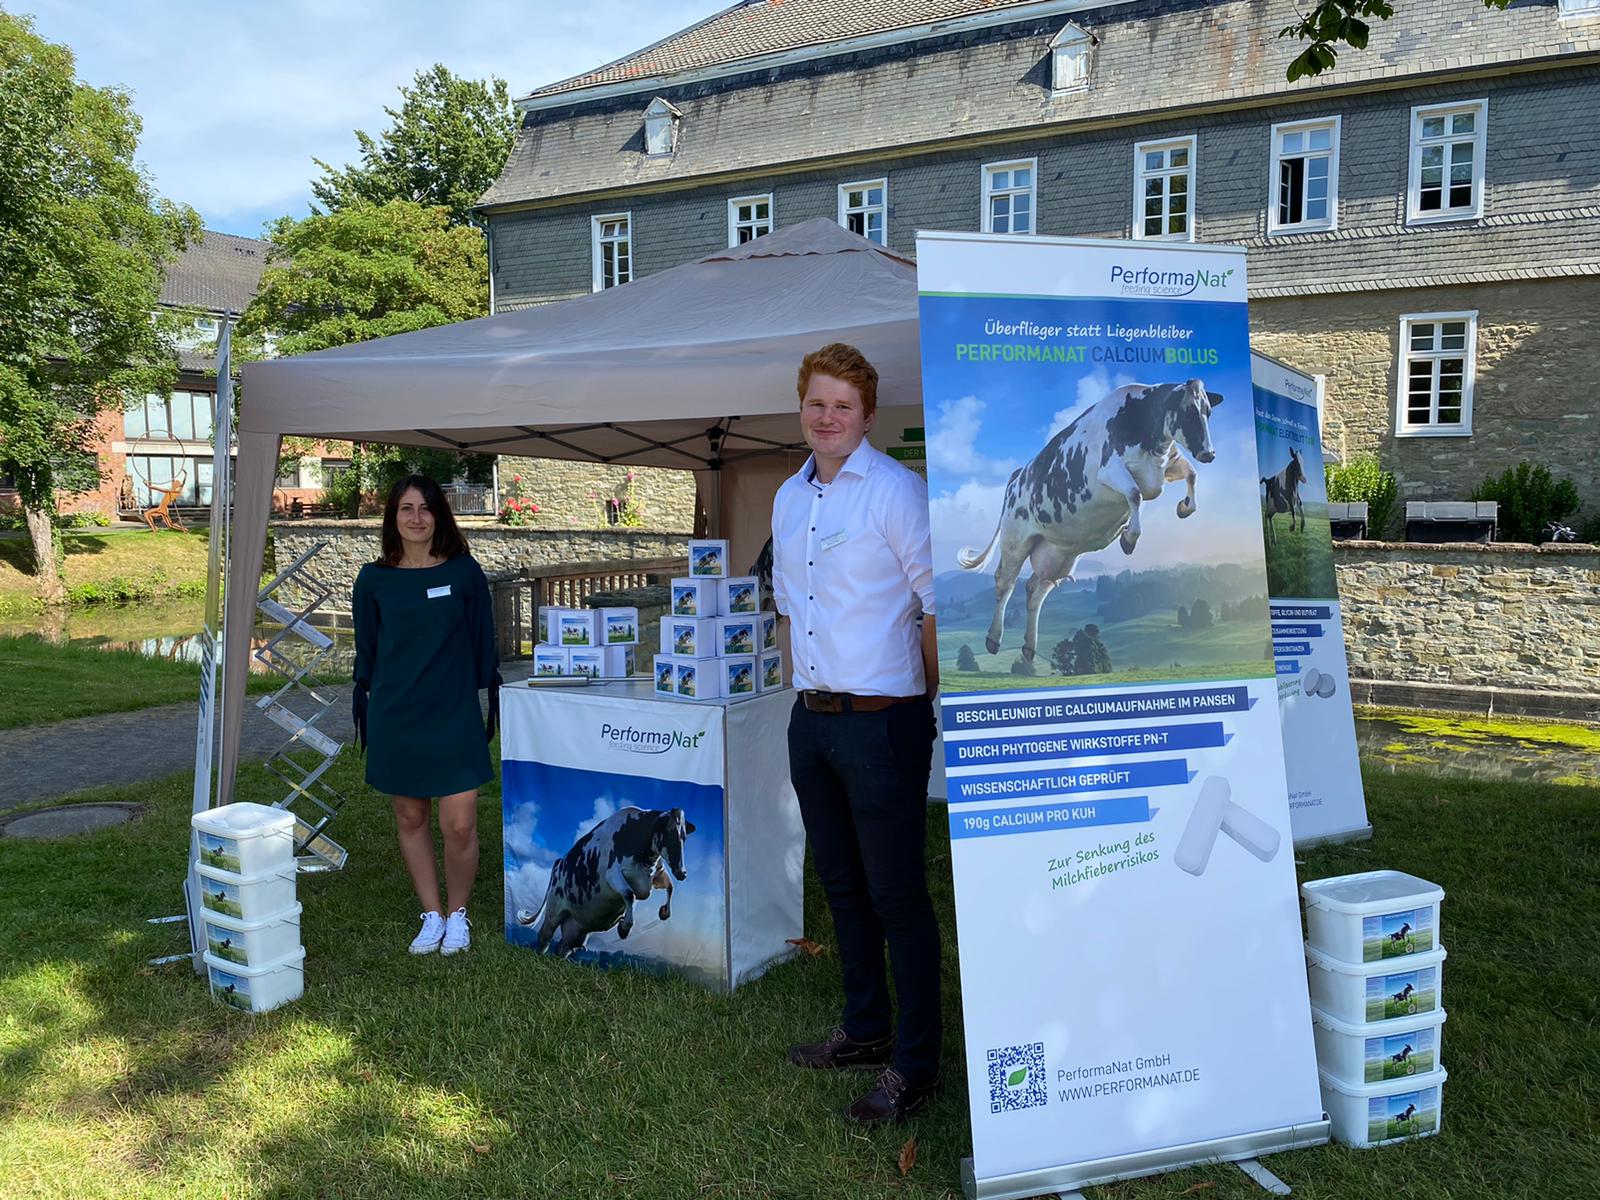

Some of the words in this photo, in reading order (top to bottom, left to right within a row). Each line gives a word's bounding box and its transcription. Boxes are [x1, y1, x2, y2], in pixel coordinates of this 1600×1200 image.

[1110, 265, 1228, 291] PerformaNat
[1120, 283, 1150, 296] feeding
[1152, 285, 1183, 295] science
[984, 318, 1063, 341] Überflieger
[1066, 323, 1102, 338] statt
[1106, 324, 1194, 343] Liegenbleiber
[955, 343, 1087, 364] PERFORMANAT
[1092, 346, 1219, 366] CALCIUMBOLUS
[955, 705, 1043, 724] BESCHLEUNIGT
[1044, 703, 1065, 719] DIE
[1065, 698, 1177, 717] CALCIUMAUFNAHME
[1178, 696, 1192, 709] IM
[1192, 693, 1236, 708] PANSEN
[601, 723, 699, 749] PerformaNat
[958, 745, 1000, 760] DURCH
[1001, 740, 1068, 757] PHYTOGENE
[1069, 734, 1142, 752] WIRKSTOFFE
[1143, 731, 1169, 746] PN-T
[960, 775, 1077, 797] WISSENSCHAFTLICH
[1078, 769, 1131, 787] GEPRÜFT
[963, 816, 990, 832] 190g
[992, 811, 1044, 828] CALCIUM
[1046, 808, 1070, 824] PRO
[1071, 806, 1097, 821] KUH
[1047, 855, 1072, 873] Zur
[1076, 839, 1131, 866] Senkung
[1134, 831, 1156, 848] des
[1051, 849, 1160, 891] Milchfieberrisikos
[1057, 1060, 1133, 1083] PerformaNat
[1135, 1053, 1171, 1070] GmbH
[1058, 1068, 1201, 1103] WWW.PERFORMANAT.DE
